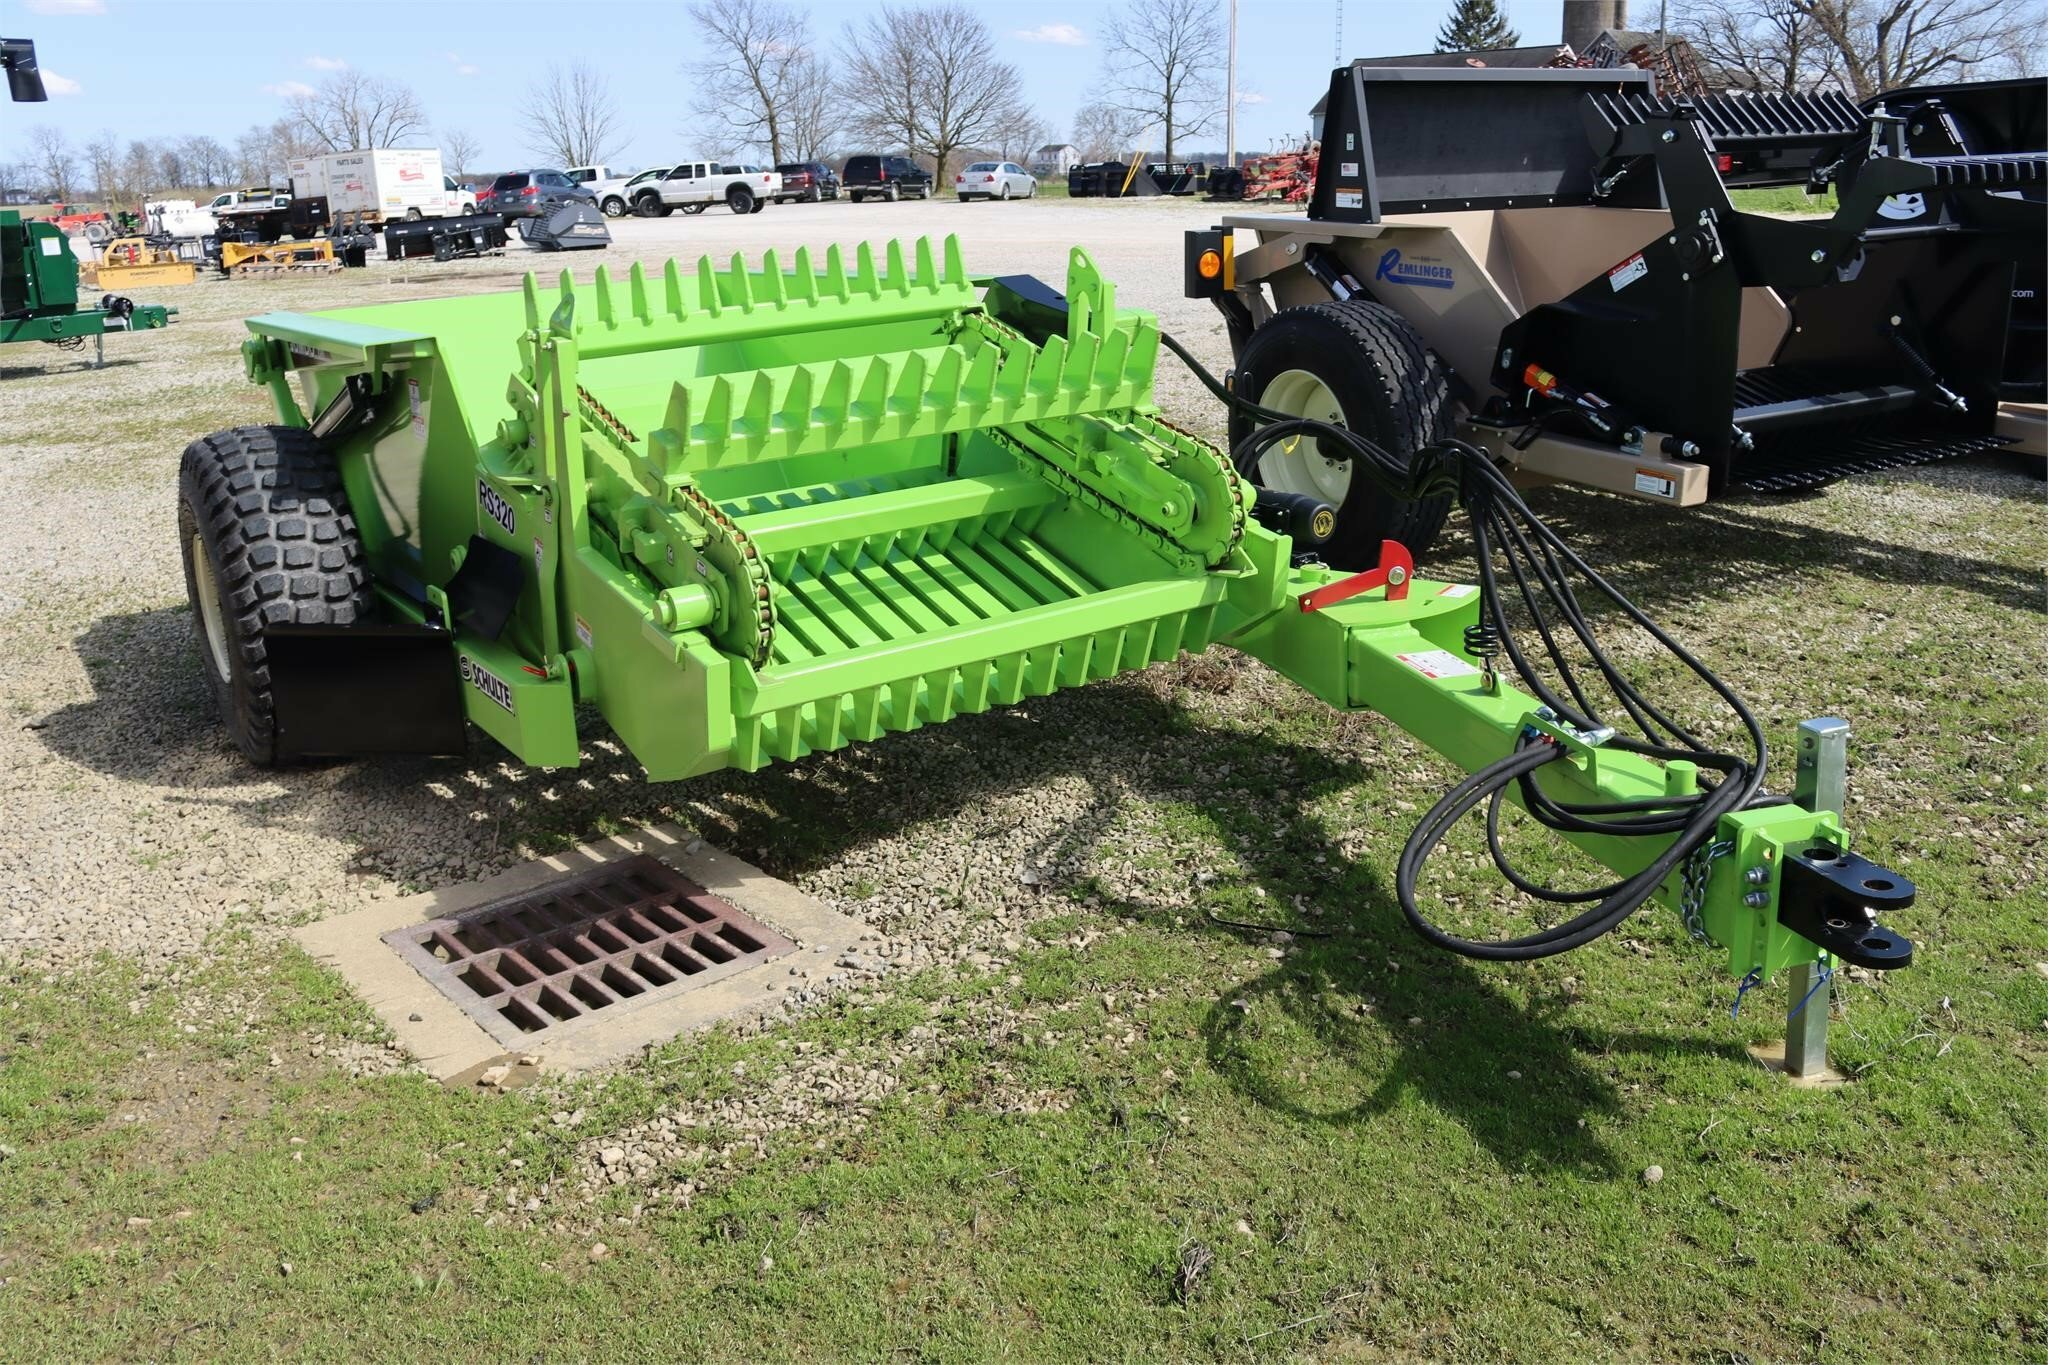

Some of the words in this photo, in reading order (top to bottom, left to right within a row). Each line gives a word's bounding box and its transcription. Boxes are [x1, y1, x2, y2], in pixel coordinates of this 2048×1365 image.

[1376, 248, 1453, 283] REMLINGER
[479, 479, 515, 535] RS320
[472, 662, 512, 710] SCHULTE
